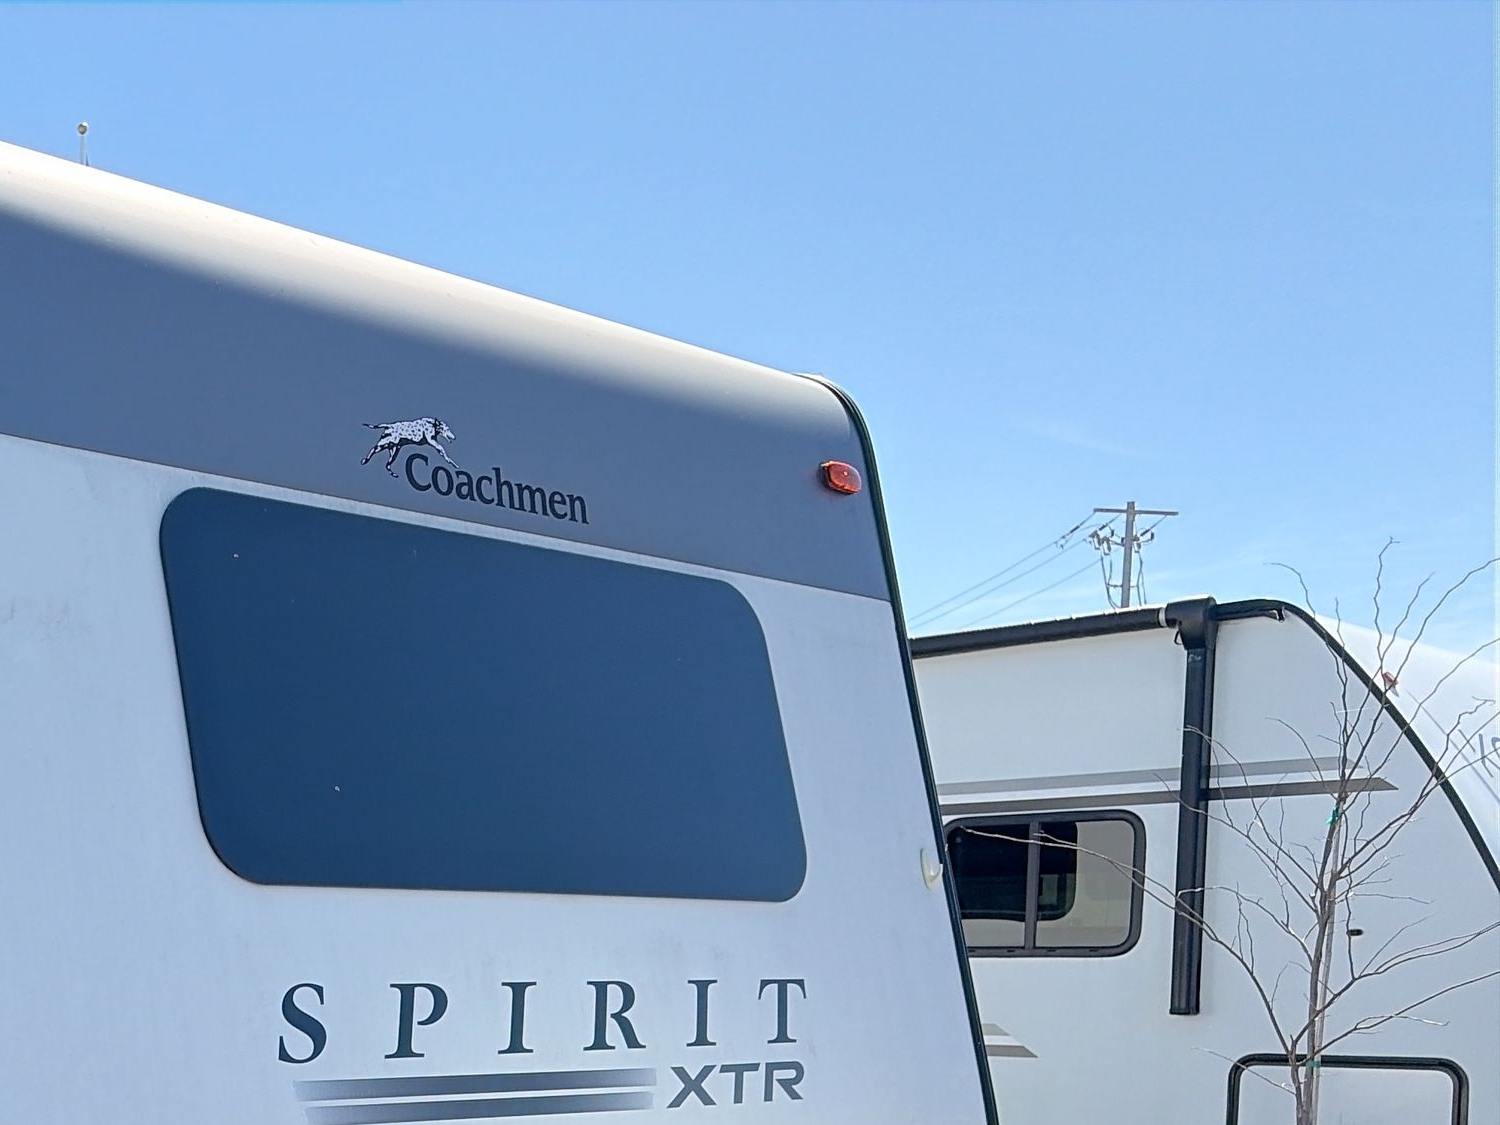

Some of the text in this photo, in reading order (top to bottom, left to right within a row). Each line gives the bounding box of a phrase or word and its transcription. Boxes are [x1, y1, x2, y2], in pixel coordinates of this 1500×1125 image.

[405, 453, 589, 525] Coachmen
[277, 978, 807, 1064] SPIRIT
[666, 1060, 805, 1109] XTR
